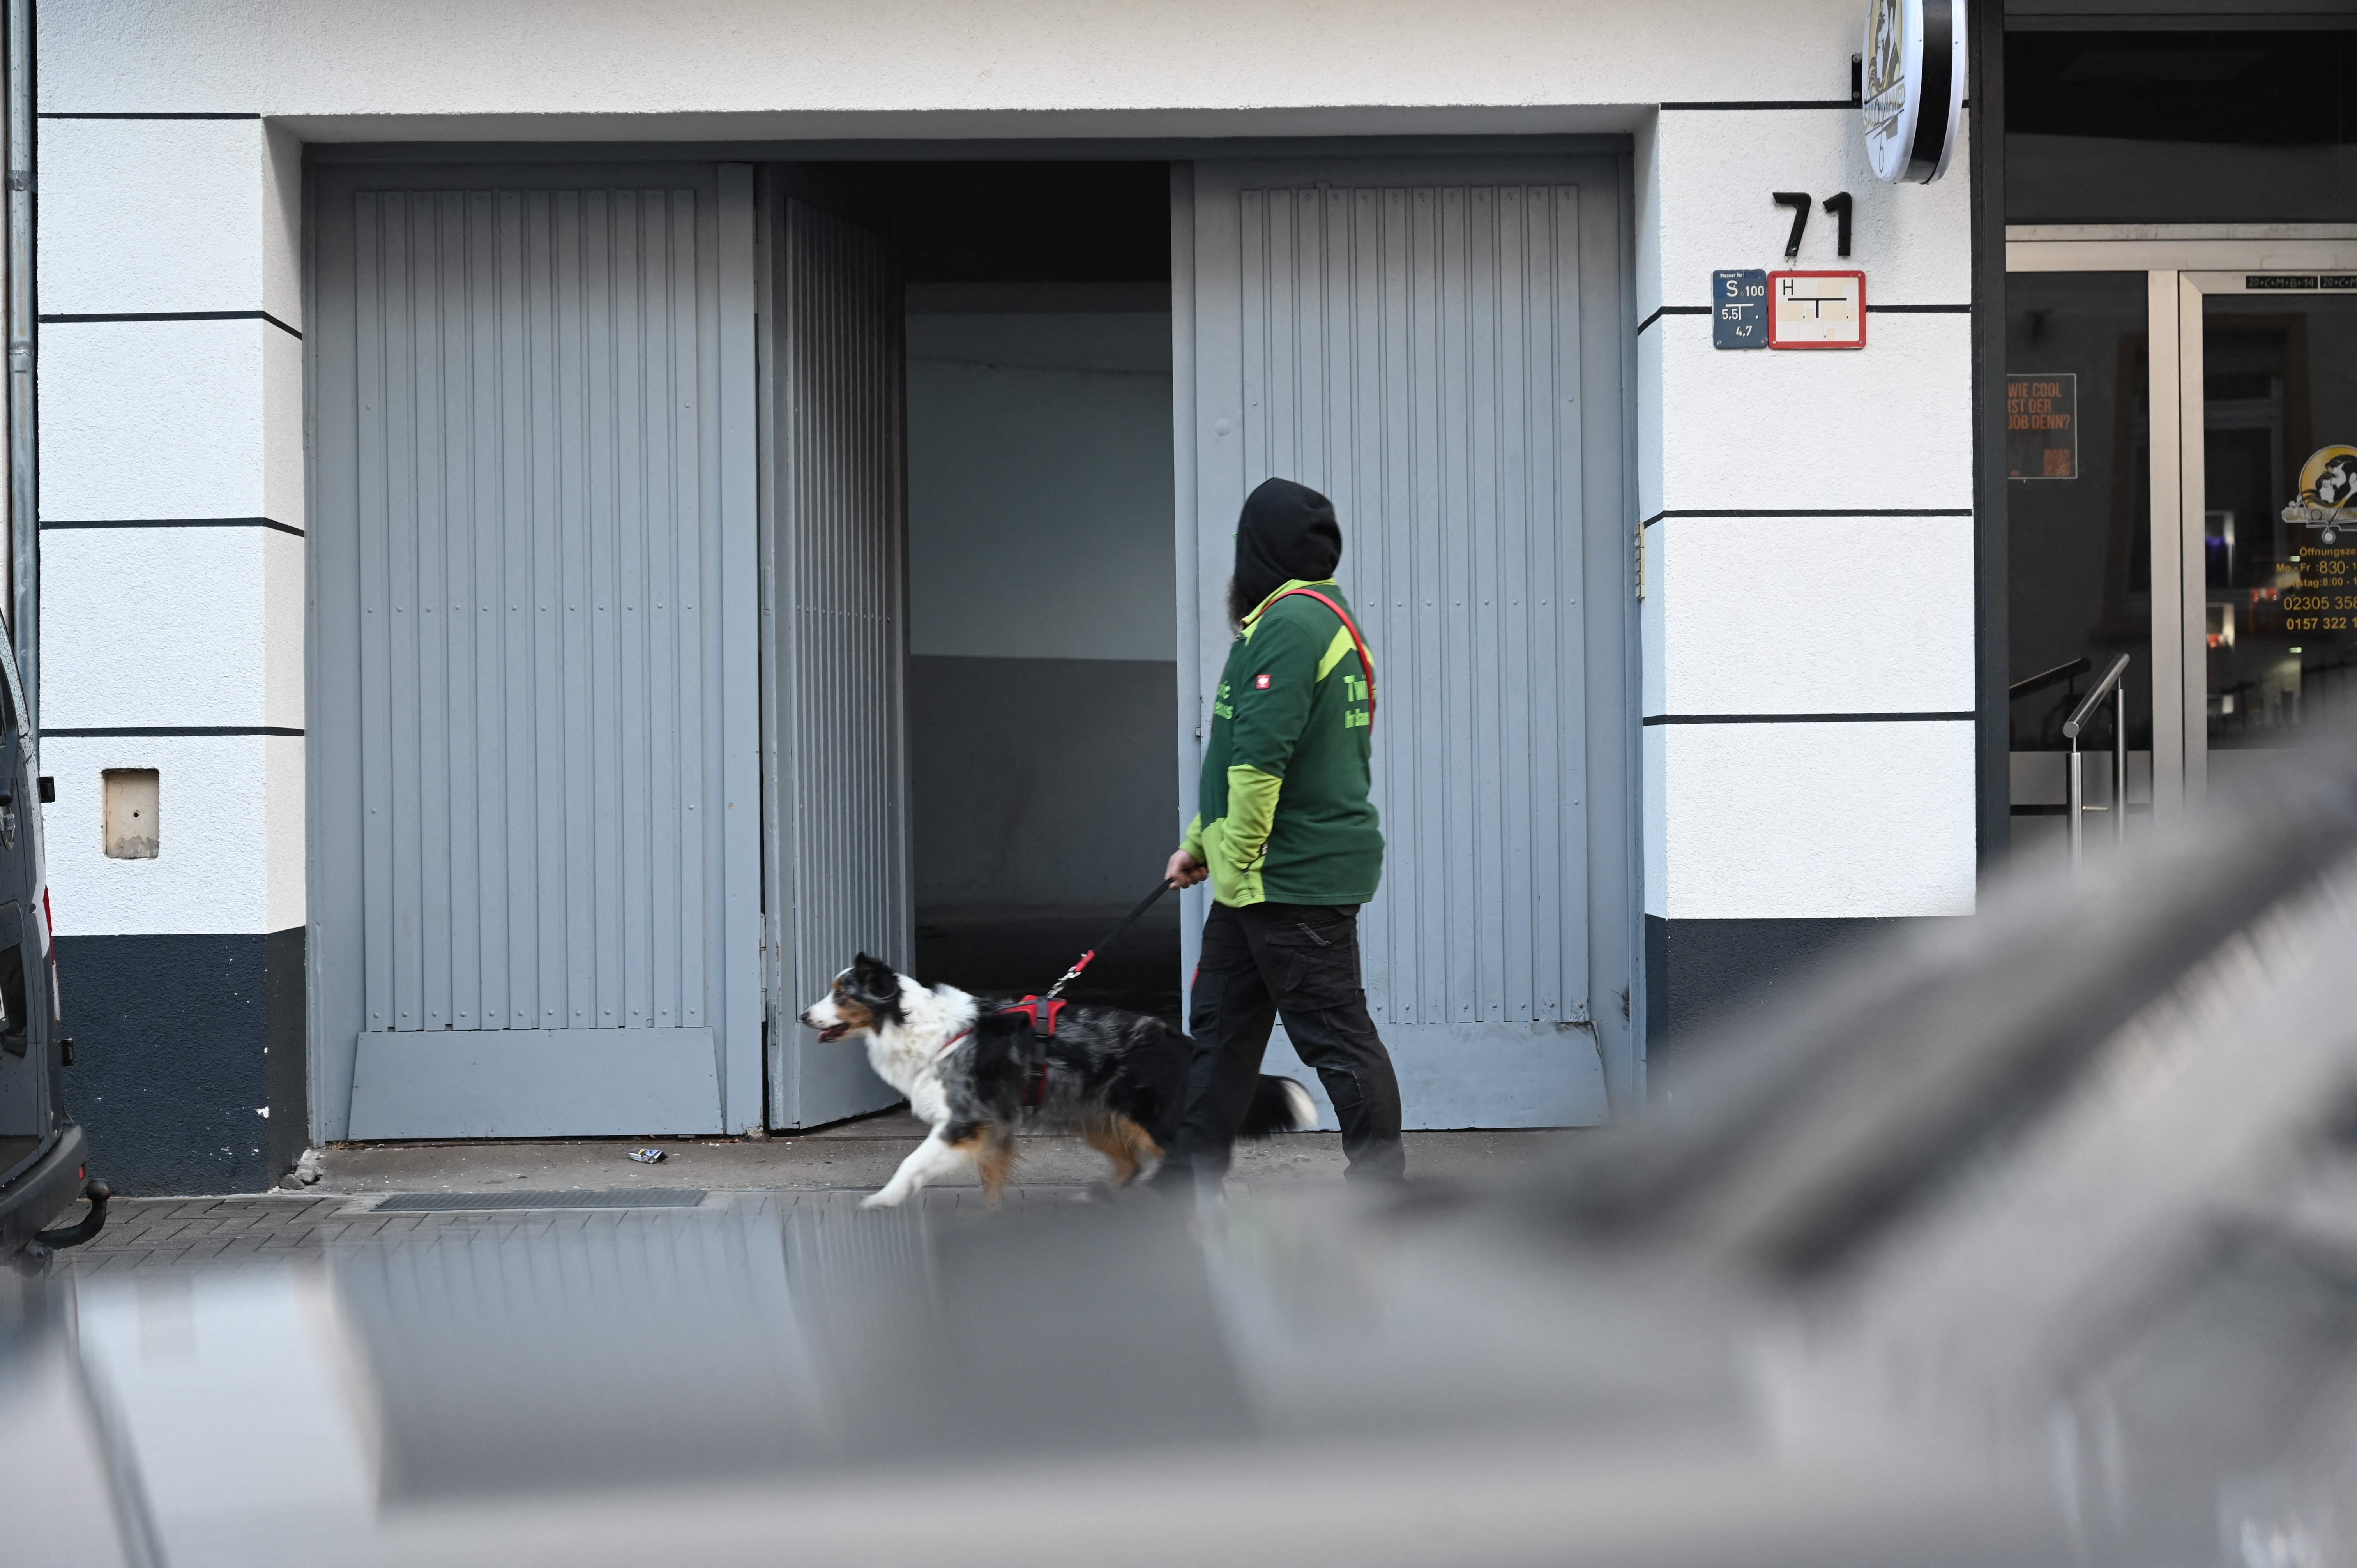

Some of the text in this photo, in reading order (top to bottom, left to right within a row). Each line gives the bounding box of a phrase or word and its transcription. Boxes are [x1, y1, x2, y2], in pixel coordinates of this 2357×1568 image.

[1772, 191, 1853, 256] 71
[1726, 280, 1764, 297] S 100
[1783, 279, 1794, 295] H
[1736, 325, 1753, 337] 4,7
[2008, 383, 2062, 397] WIE COOL
[2008, 399, 2052, 413] IST DER
[2008, 414, 2071, 430] JOB DENN?
[2284, 596, 2329, 611] 02305
[2286, 617, 2318, 630] 0157
[2323, 616, 2347, 629] 322
